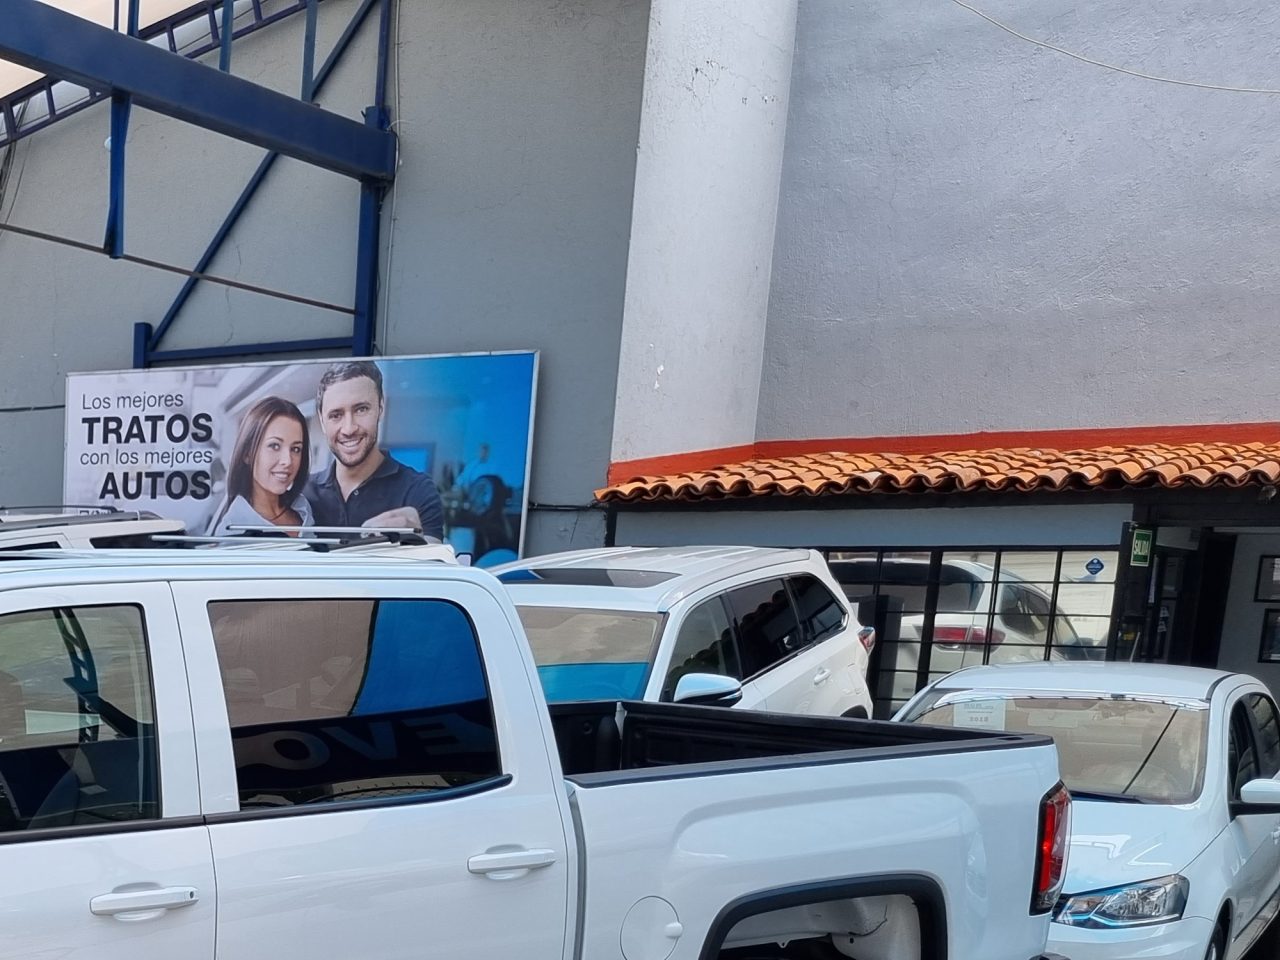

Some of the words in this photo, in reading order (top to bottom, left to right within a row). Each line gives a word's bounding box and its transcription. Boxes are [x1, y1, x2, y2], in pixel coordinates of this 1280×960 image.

[82, 394, 111, 410] Los
[117, 391, 184, 412] mejores
[82, 413, 213, 445] TRATOS
[80, 452, 109, 465] con
[115, 449, 139, 465] los
[145, 448, 213, 468] mejores
[99, 470, 211, 500] AUTOS
